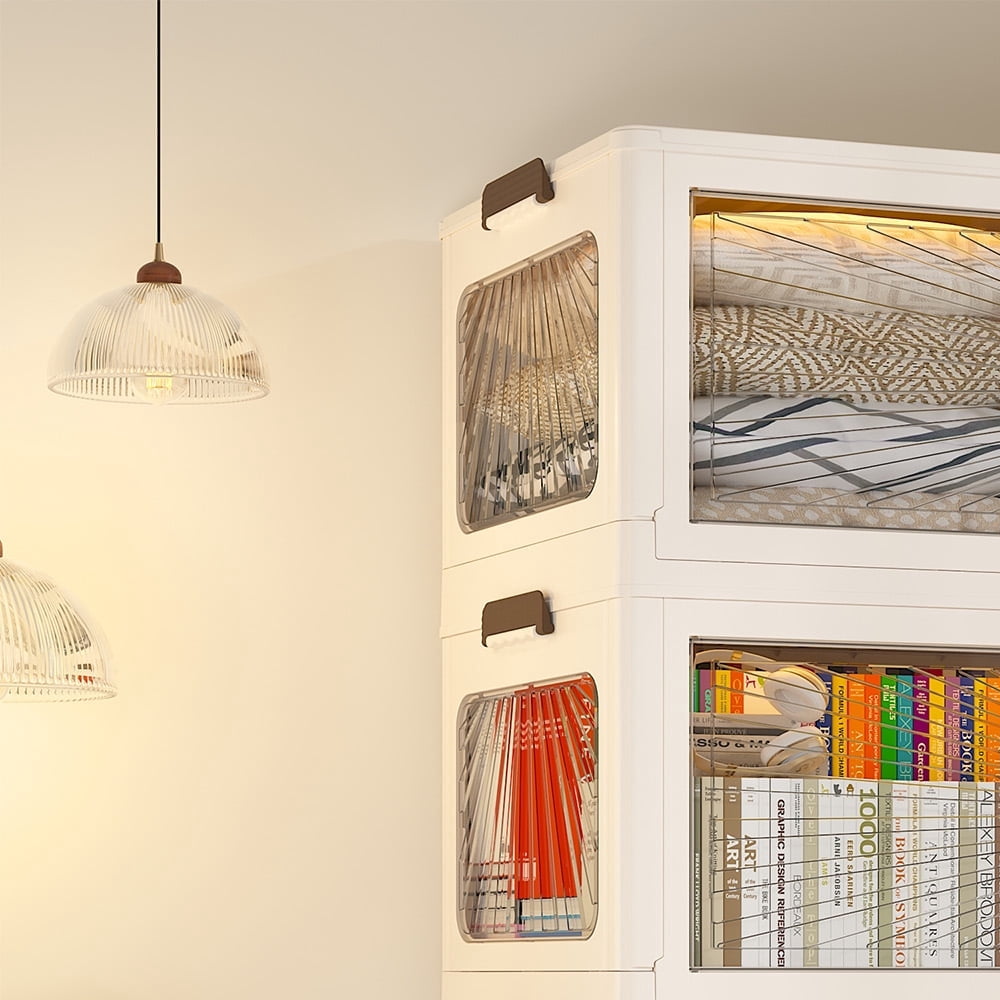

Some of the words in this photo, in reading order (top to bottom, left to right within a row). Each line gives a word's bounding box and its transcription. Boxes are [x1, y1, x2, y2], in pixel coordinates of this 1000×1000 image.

[899, 683, 911, 754] ALEXEY
[916, 743, 926, 781] Garden
[961, 731, 972, 773] BOOK
[777, 799, 786, 850] GRAPHIC
[859, 788, 877, 858] 1000
[981, 789, 993, 867] ALEXEY
[726, 833, 739, 872] ART
[744, 834, 757, 873] ART
[777, 853, 786, 895] DESIGN
[894, 836, 906, 884] BOOK
[793, 875, 802, 937] BORDEAUX
[928, 842, 938, 957] ANTQUARES
[777, 898, 786, 967] REFERENCE
[894, 903, 906, 967] SYMBO
